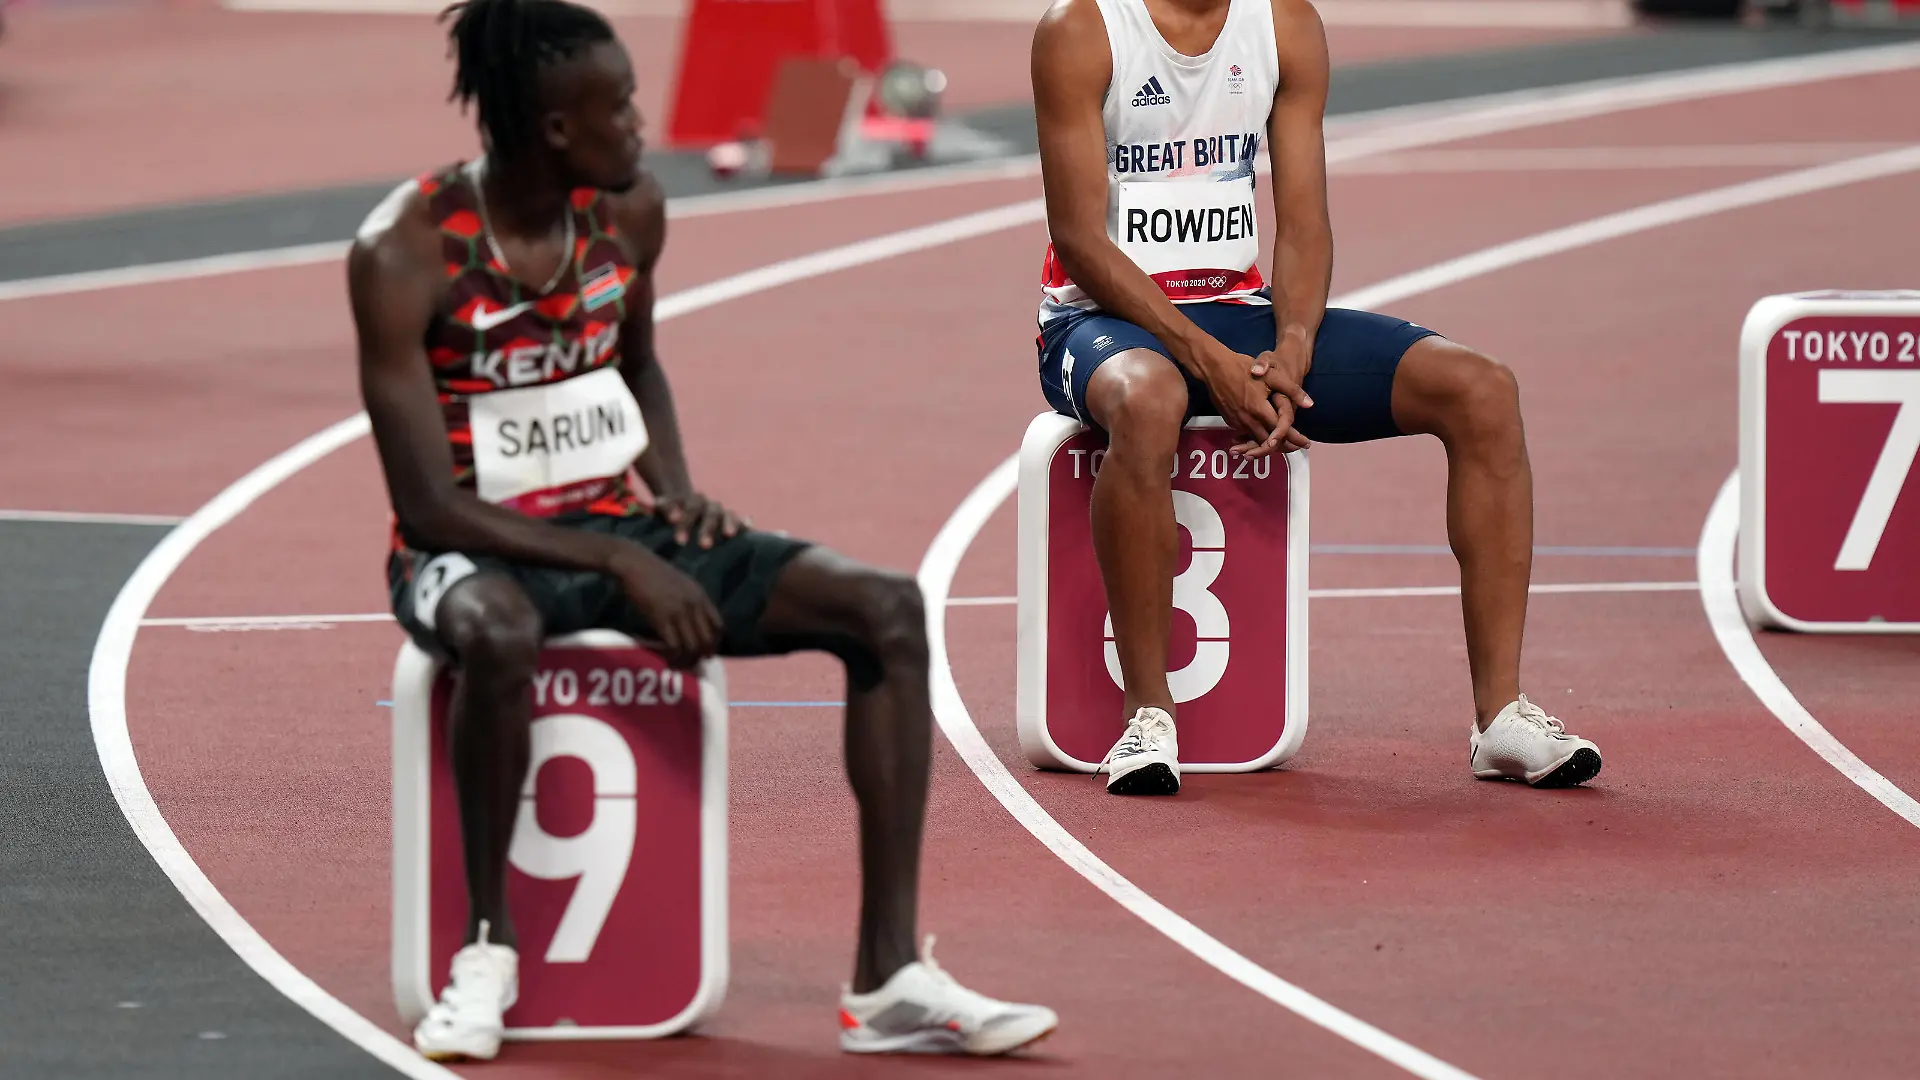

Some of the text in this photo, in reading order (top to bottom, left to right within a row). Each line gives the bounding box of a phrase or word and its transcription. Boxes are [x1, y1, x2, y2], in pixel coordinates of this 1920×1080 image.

[1131, 94, 1171, 108] adidas
[1115, 133, 1258, 173] GREAT BRITIN
[1127, 203, 1254, 243] ROWDEN
[1165, 279, 1206, 288] TOKYO 2020
[1783, 330, 1890, 362] TOKYO
[499, 399, 626, 458] SARUNI
[1189, 449, 1271, 480] 2020
[1818, 368, 1920, 570] 7
[586, 667, 684, 707] 2020
[508, 713, 637, 963] 9
